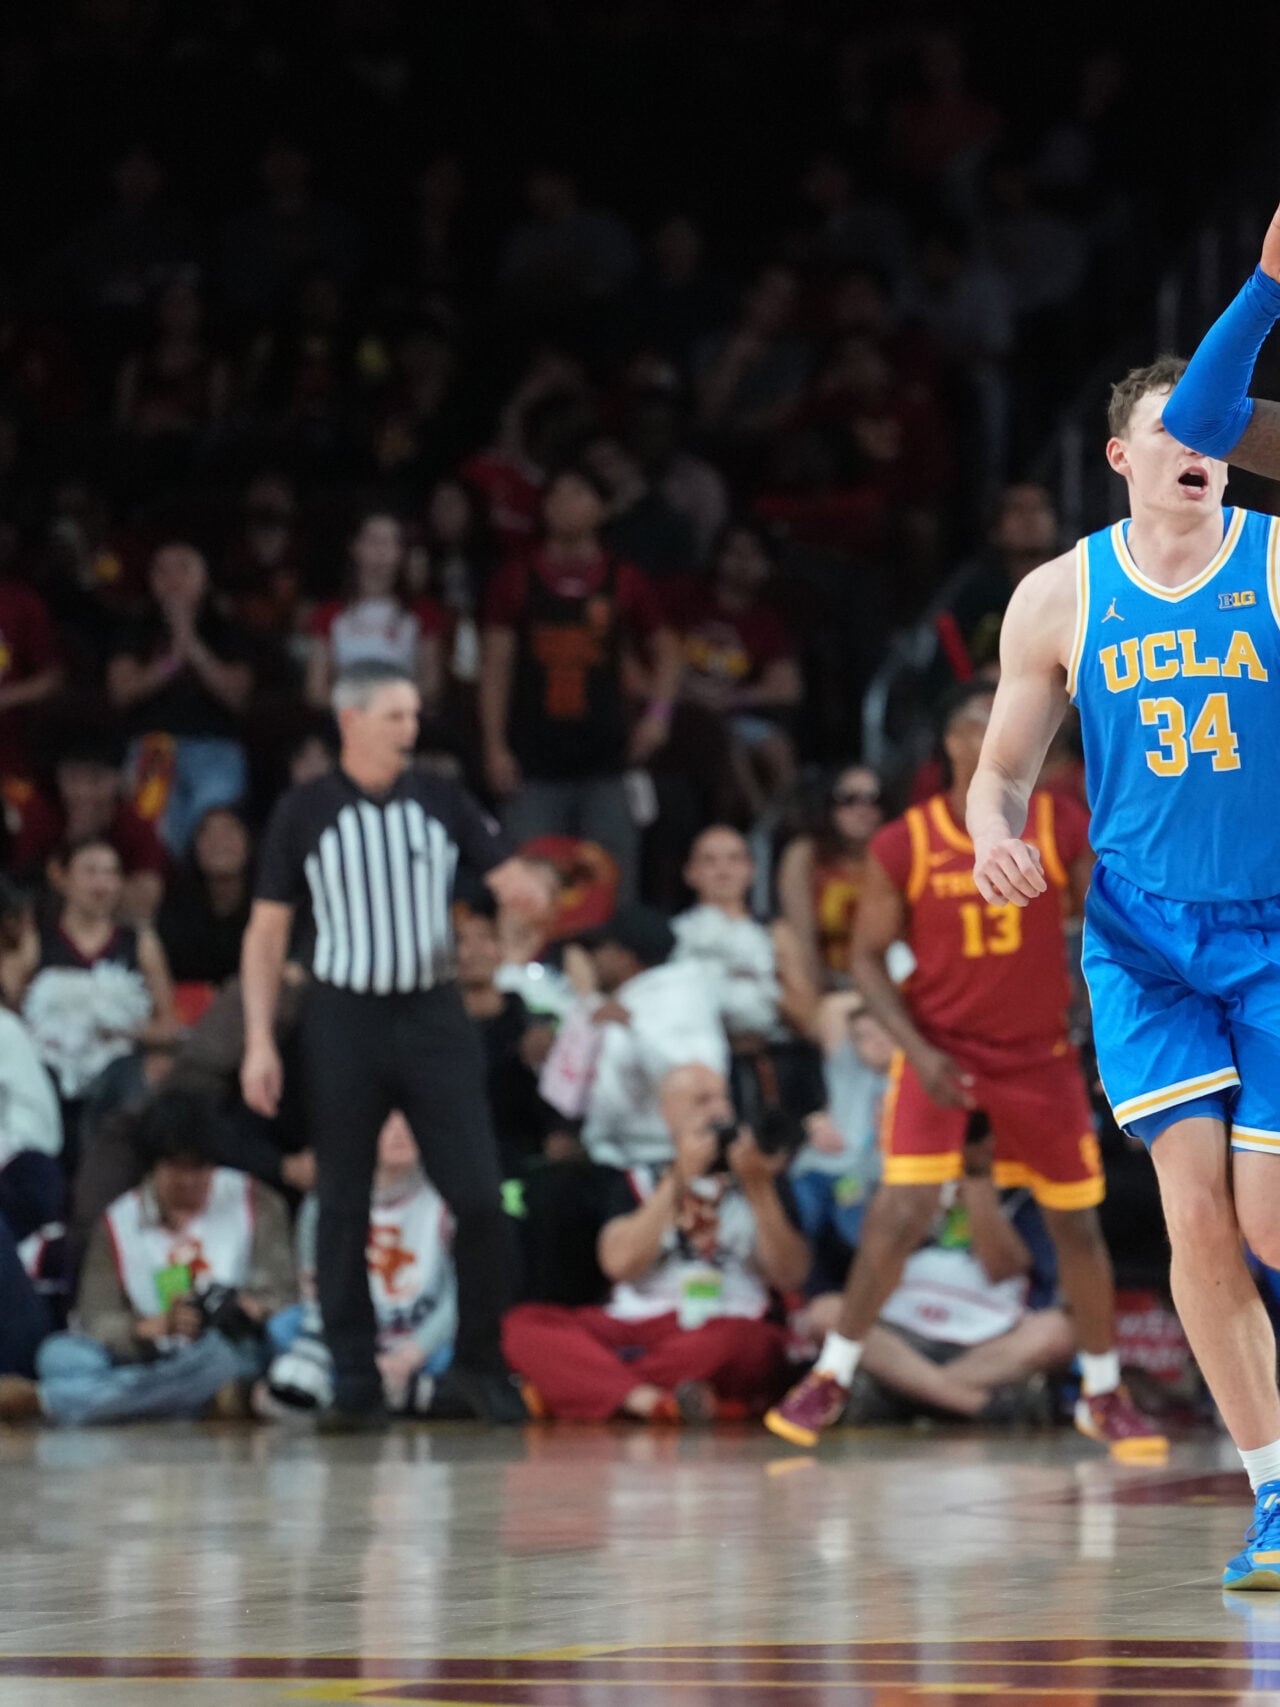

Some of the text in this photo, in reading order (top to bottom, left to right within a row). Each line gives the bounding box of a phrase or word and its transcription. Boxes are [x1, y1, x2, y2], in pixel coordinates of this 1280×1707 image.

[1099, 628, 1269, 694] UCLA
[1138, 692, 1241, 777] 34
[960, 900, 1021, 957] 13
